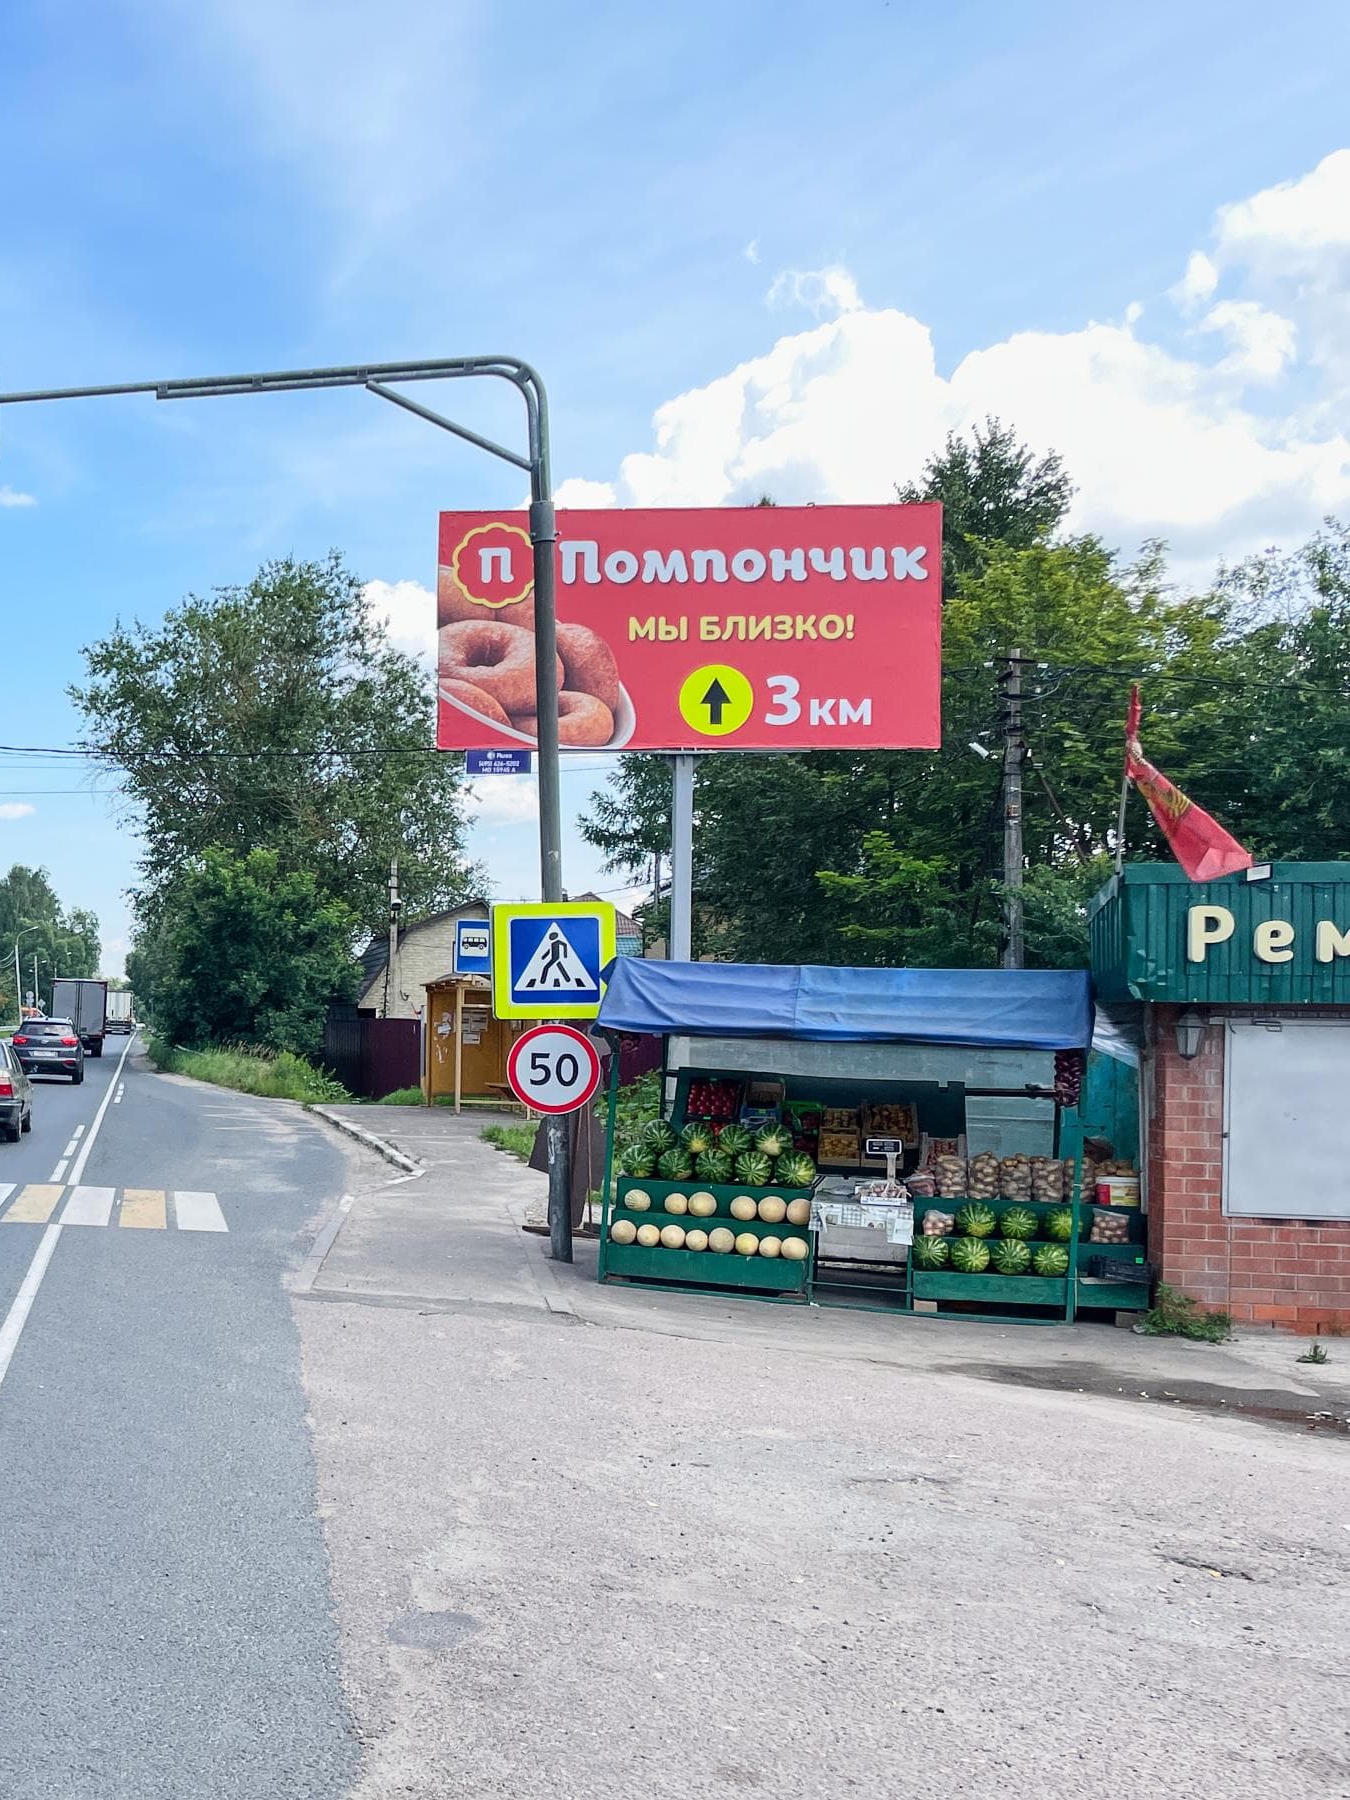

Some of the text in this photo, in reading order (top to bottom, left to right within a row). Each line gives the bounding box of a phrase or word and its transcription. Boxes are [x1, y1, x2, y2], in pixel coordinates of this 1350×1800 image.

[478, 547, 514, 583] П
[559, 540, 929, 584] Помпончик
[628, 614, 855, 641] МЫ БЛИЗКО!
[764, 674, 872, 726] 3 км
[530, 1052, 579, 1087] 50
